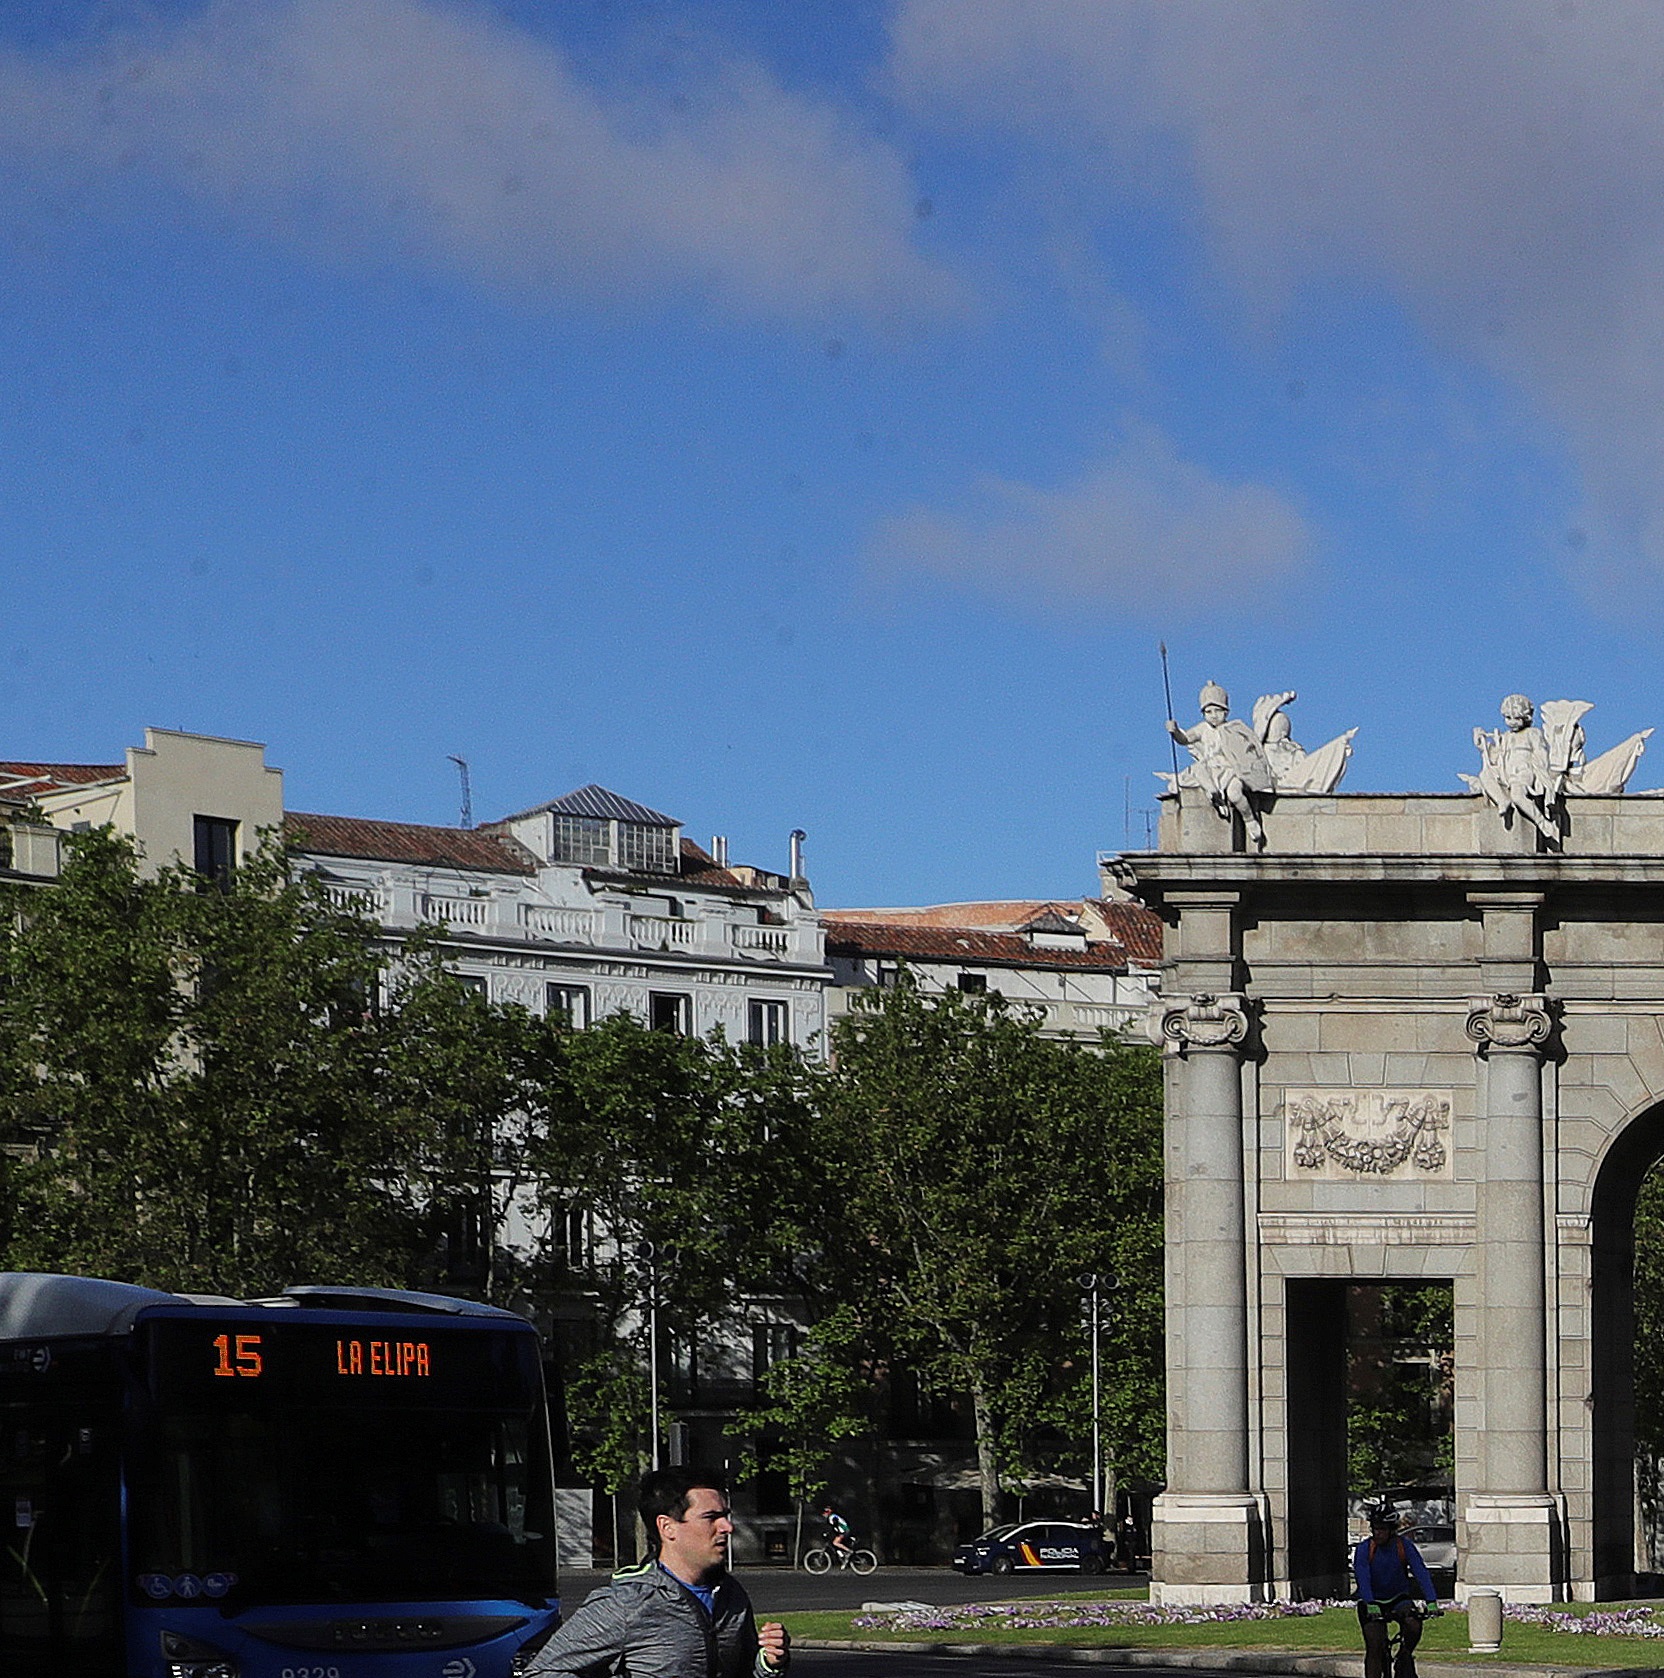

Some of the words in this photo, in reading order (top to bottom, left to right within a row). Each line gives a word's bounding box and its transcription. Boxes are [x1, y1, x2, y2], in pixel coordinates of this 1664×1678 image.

[212, 1334, 264, 1378] 15
[336, 1340, 363, 1375] LA
[369, 1341, 431, 1377] ELIPA
